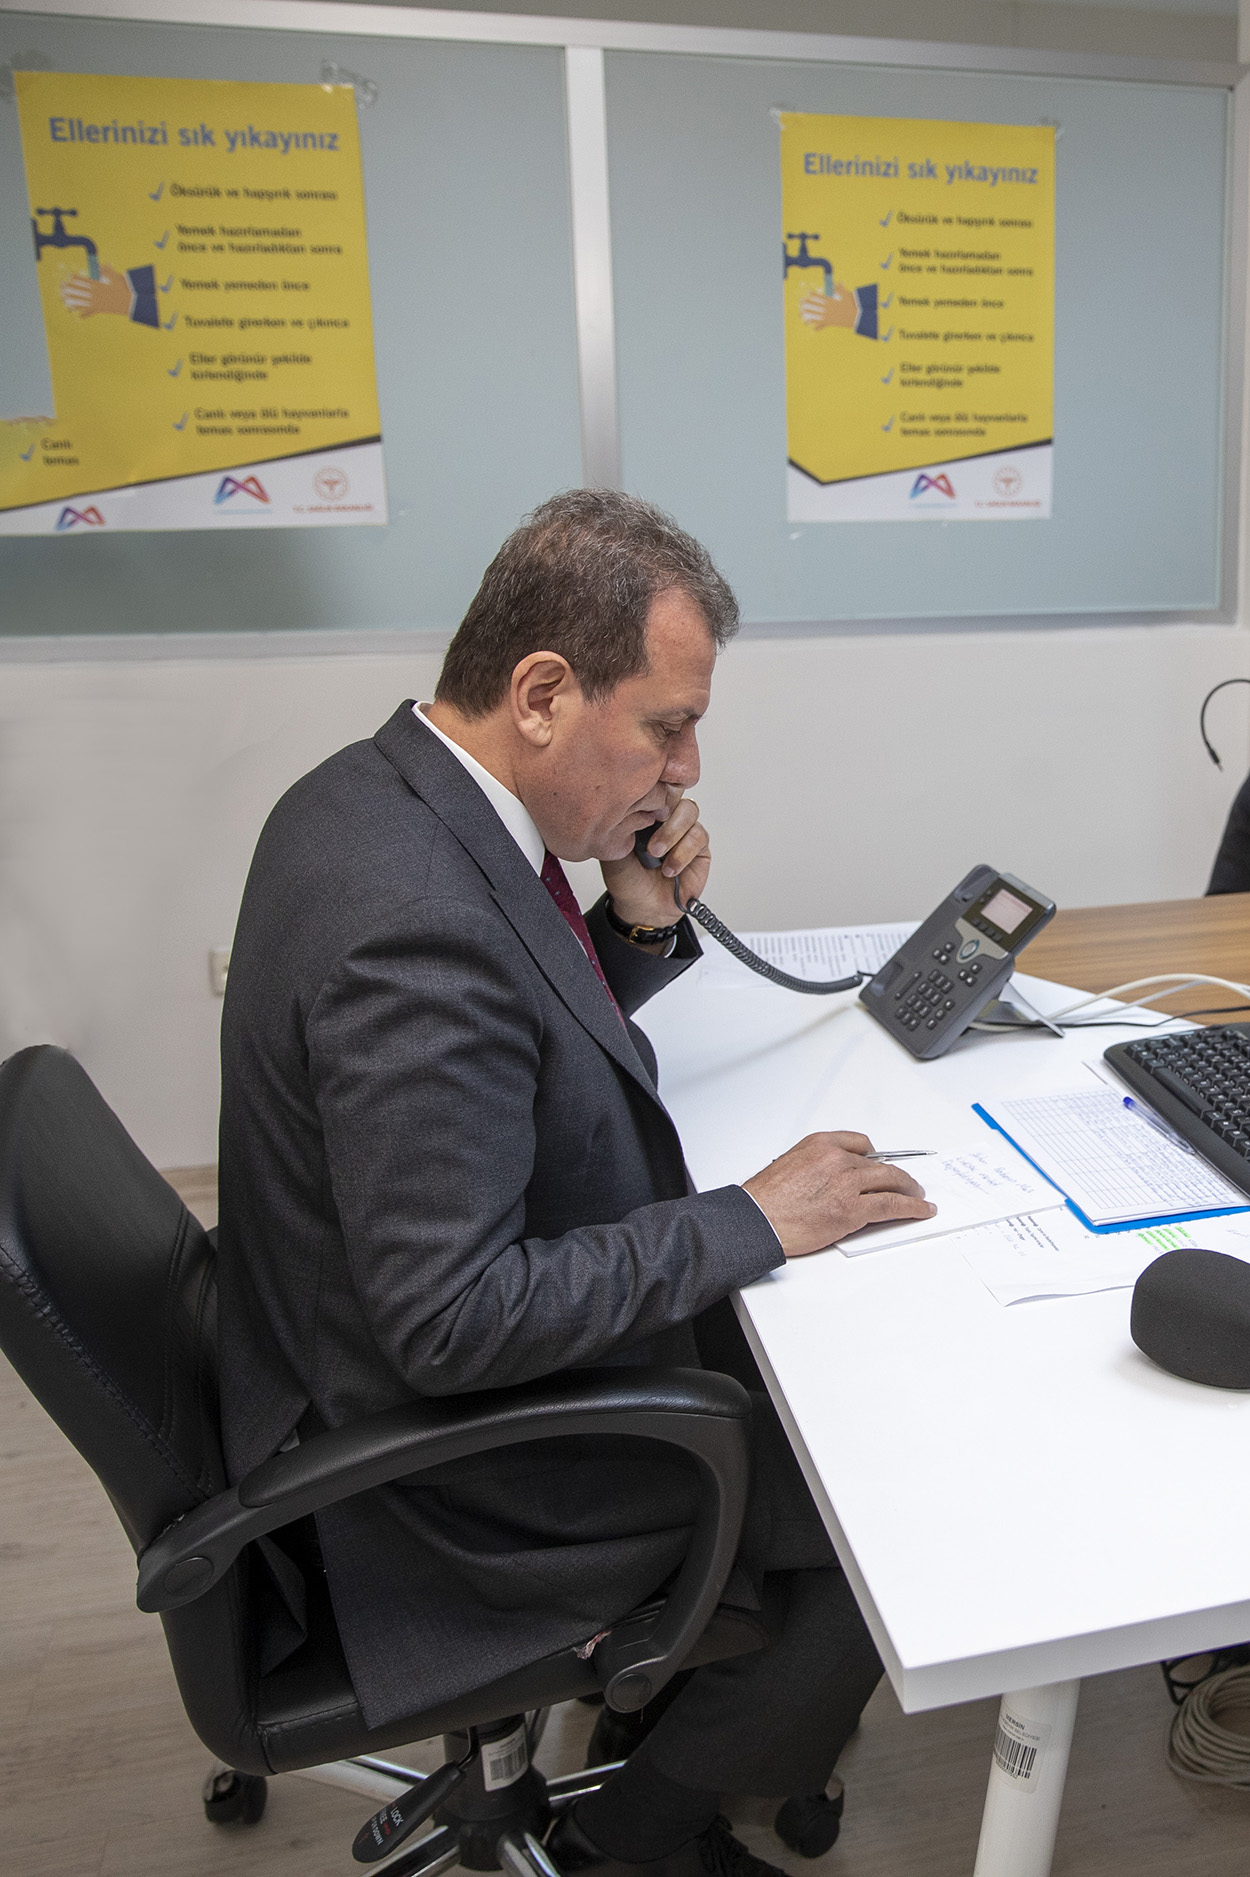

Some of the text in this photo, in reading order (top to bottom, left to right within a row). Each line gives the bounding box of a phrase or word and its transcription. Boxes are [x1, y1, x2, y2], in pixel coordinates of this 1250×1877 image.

[50, 117, 339, 155] Ellerinizi sık yıkayınız
[804, 152, 1038, 187] Ellerinizi sık yıkayınız
